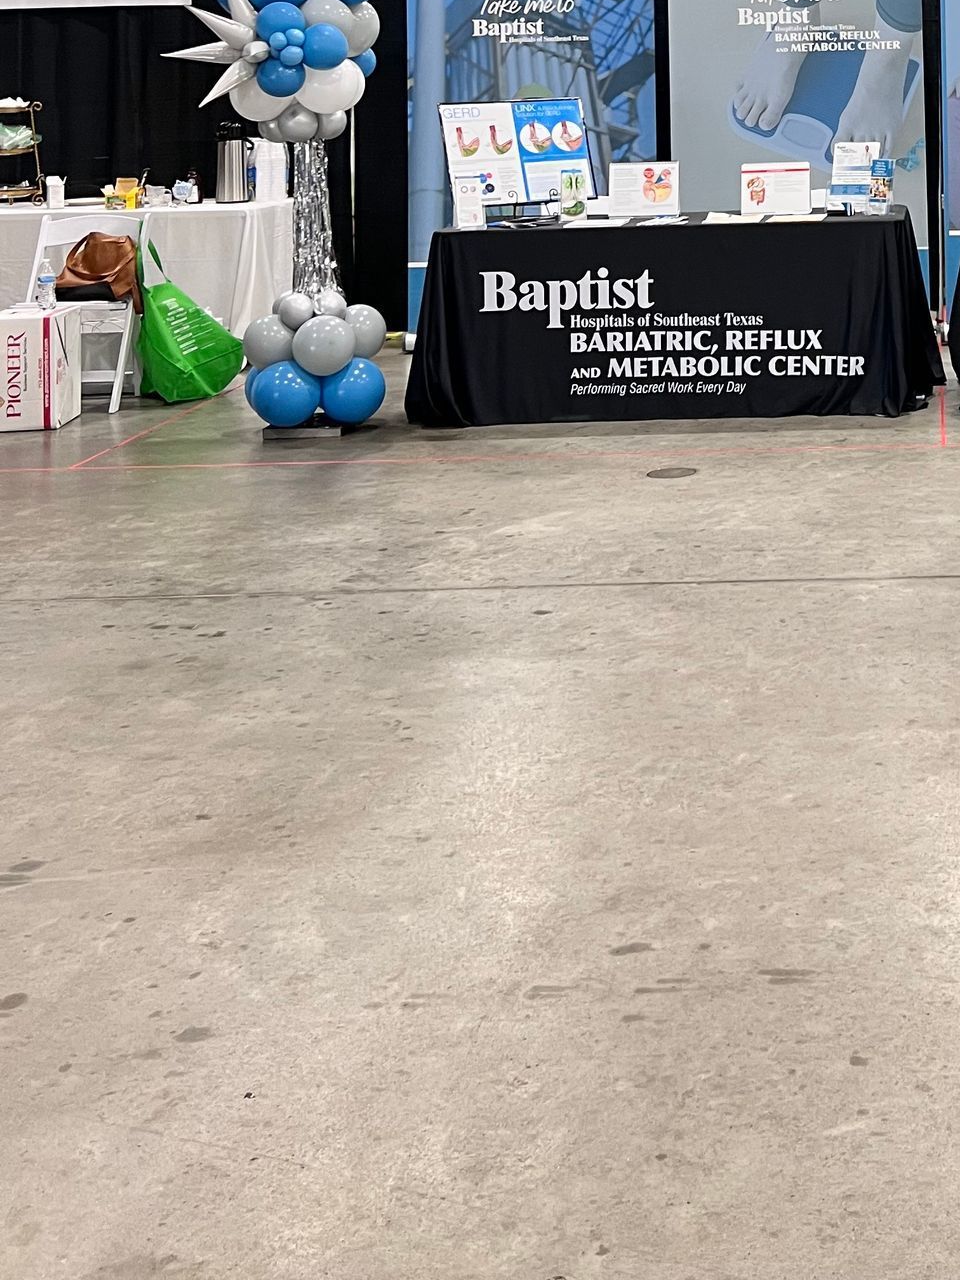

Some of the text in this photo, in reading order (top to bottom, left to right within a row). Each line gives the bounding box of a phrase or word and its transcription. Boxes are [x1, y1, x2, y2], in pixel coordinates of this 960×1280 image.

[524, 0, 556, 14] me
[737, 6, 810, 32] Baptist
[472, 18, 544, 43] Baptist
[775, 30, 880, 42] BARIATRIC, REFLUX
[790, 42, 855, 53] METABOLIC
[858, 40, 901, 51] CENTER
[443, 107, 480, 119] GERD
[478, 267, 655, 329] Baptist
[570, 312, 763, 331] Hospitals of Southeast Texas
[570, 329, 822, 354] BARIATRIC, REFLUX
[6, 332, 26, 418] PIONEER
[570, 355, 865, 379] AND METABOLIC CENTER
[570, 380, 746, 396] Performing Sacred Work Every Day
